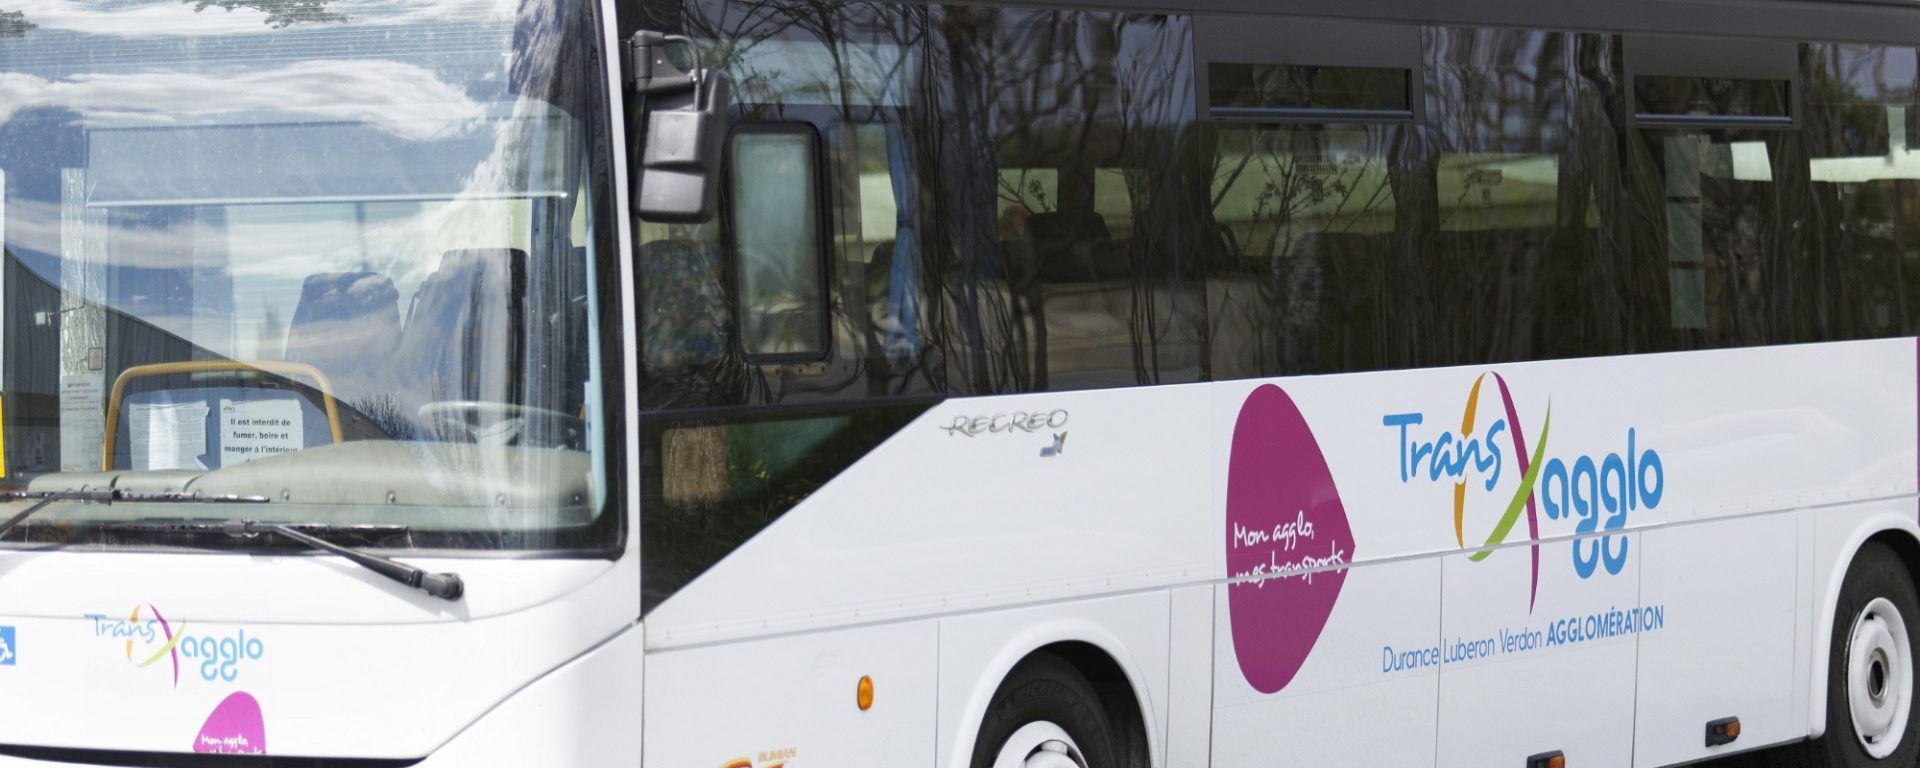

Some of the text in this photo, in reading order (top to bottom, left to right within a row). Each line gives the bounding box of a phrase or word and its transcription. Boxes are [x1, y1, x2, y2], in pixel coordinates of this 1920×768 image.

[230, 418, 236, 426] Il
[252, 418, 280, 426] interdit
[281, 418, 291, 426] de
[233, 431, 289, 440] fumer, boire et
[939, 408, 1068, 437] RECREO
[224, 446, 253, 455] manger
[1383, 413, 1664, 579] Trans agglo
[1234, 510, 1314, 551] Mon agglo,
[84, 613, 264, 681] Trans agglo
[1382, 605, 1664, 673] Durance Luberon Verdon AGGLOMÉRATION
[201, 733, 223, 745] Mon
